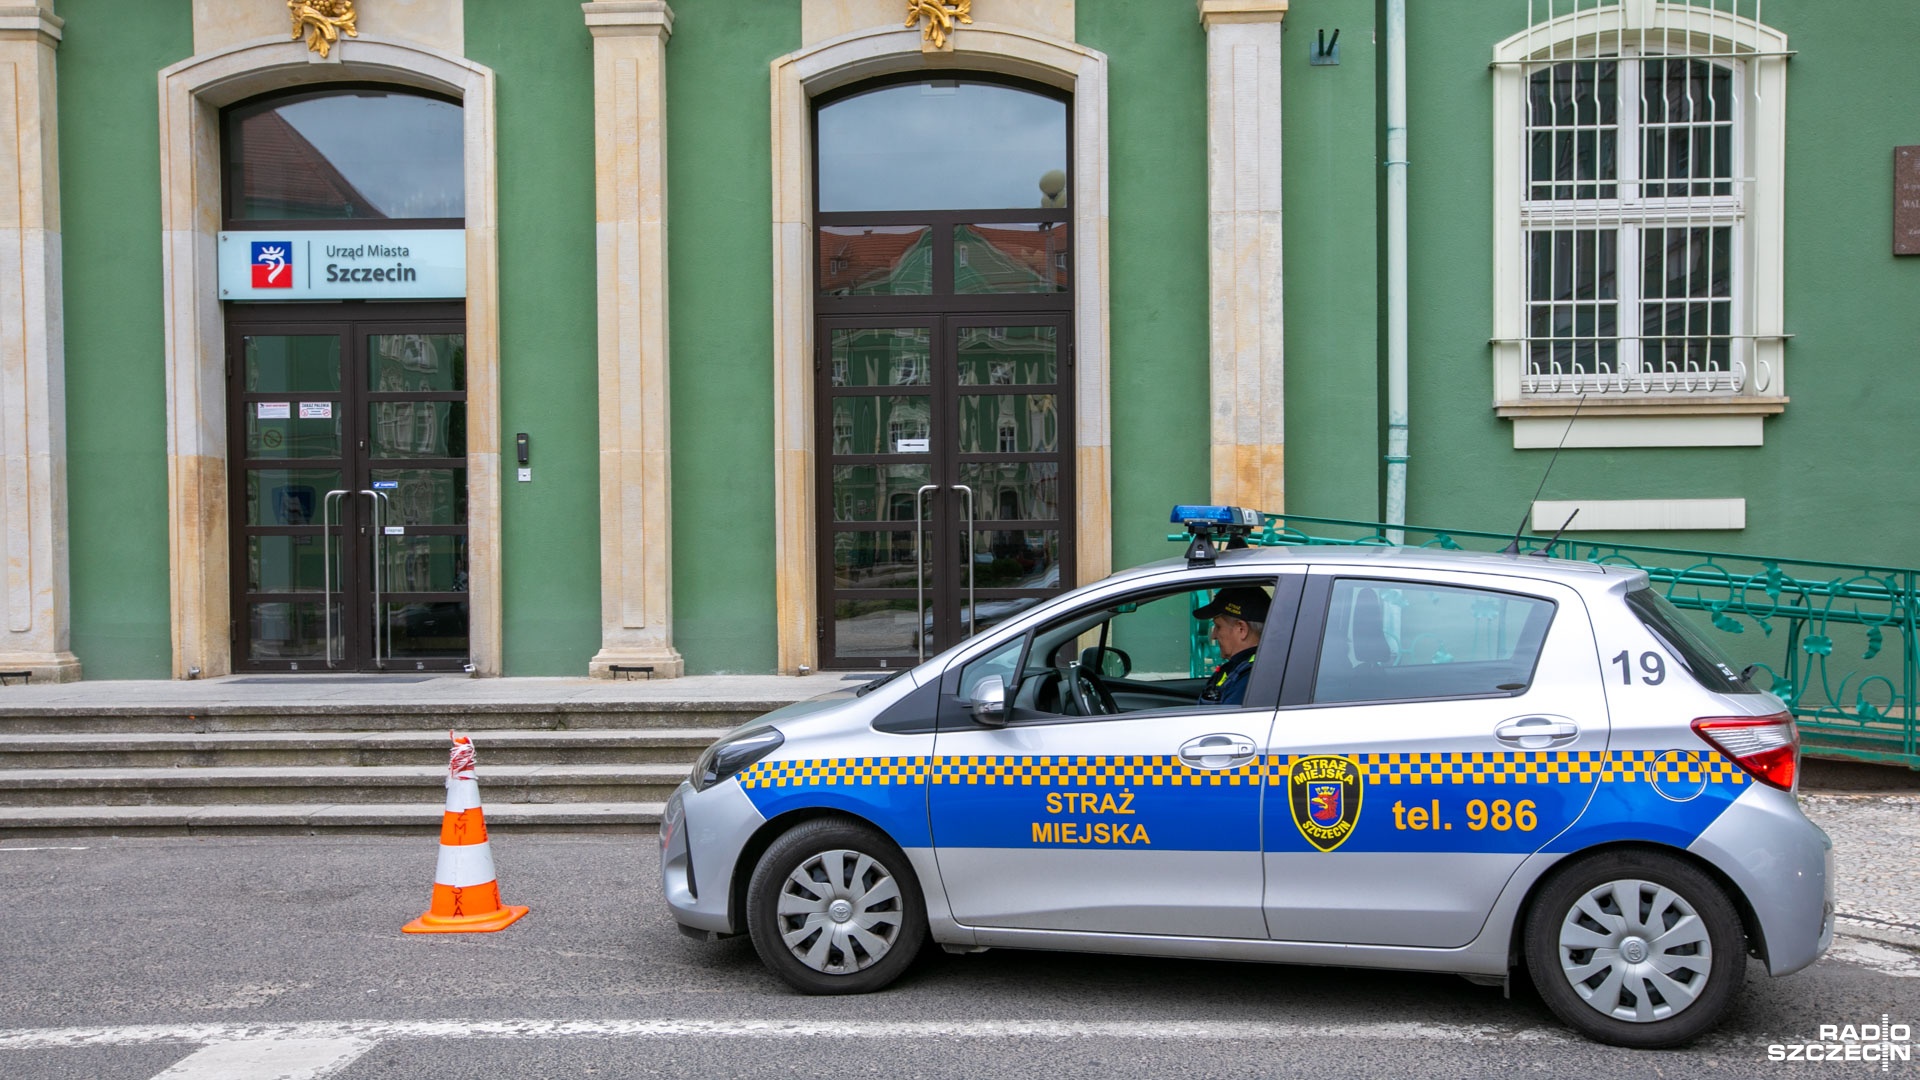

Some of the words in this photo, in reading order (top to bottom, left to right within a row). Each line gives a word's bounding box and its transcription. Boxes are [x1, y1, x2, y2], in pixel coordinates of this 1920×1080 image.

[326, 244, 364, 260] Urząd
[367, 245, 410, 257] Miasta
[326, 262, 416, 282] Szczecin
[1612, 650, 1666, 686] 19
[1293, 768, 1354, 785] MIEJSKA
[1046, 788, 1135, 814] STRAŻ
[1392, 799, 1452, 830] tel.
[1465, 799, 1538, 831] 986
[1032, 822, 1151, 844] MIEJSKA
[1302, 820, 1351, 839] SZCZECIN
